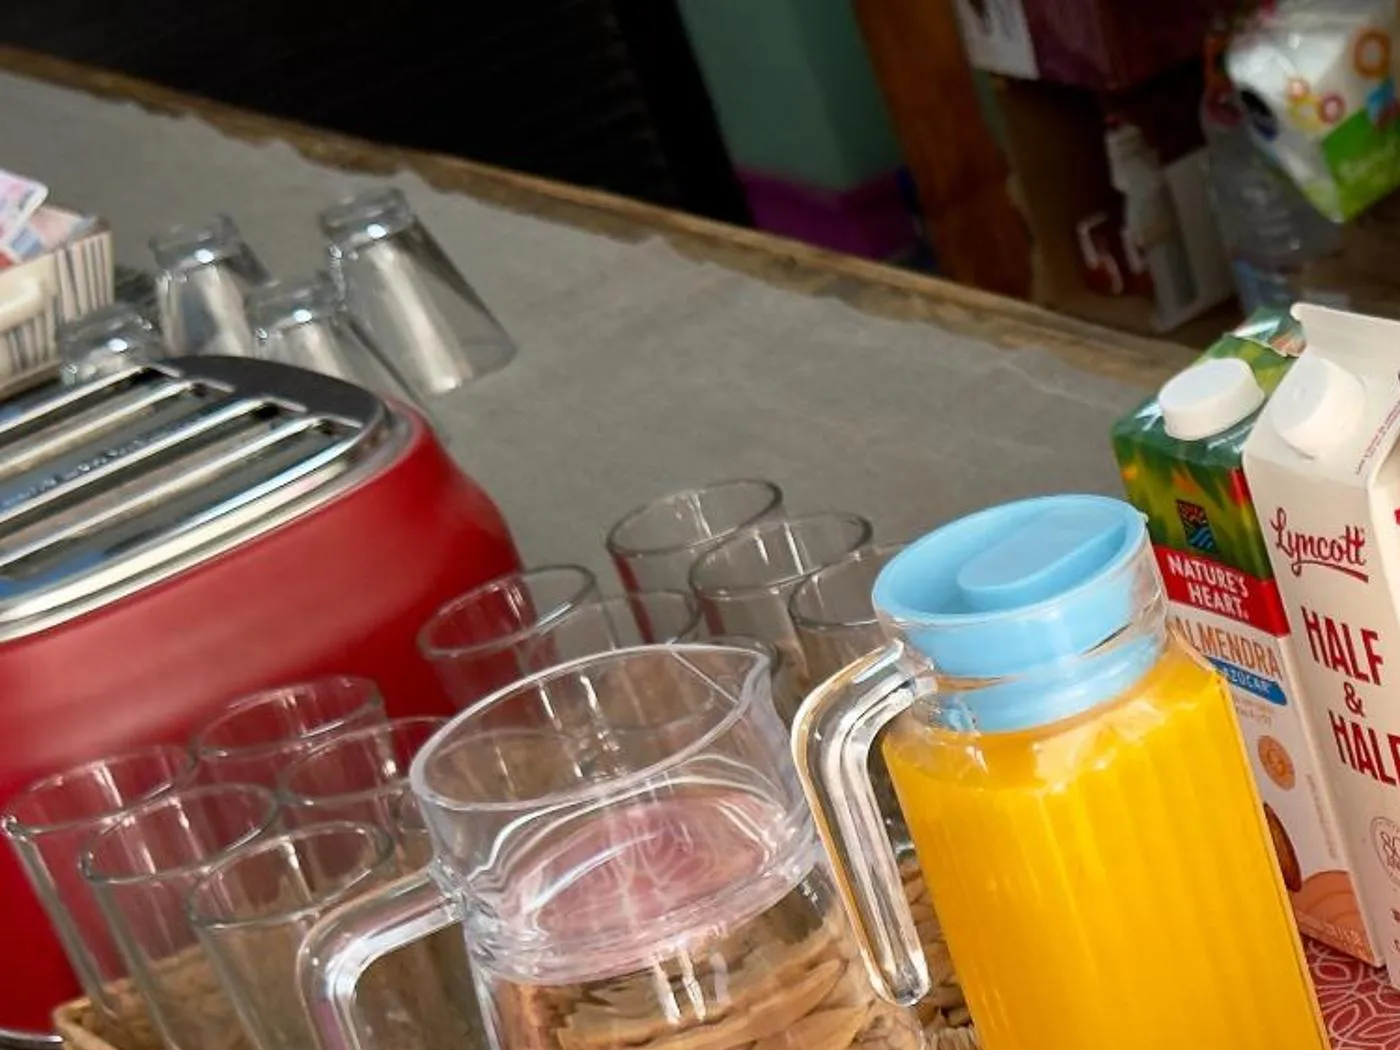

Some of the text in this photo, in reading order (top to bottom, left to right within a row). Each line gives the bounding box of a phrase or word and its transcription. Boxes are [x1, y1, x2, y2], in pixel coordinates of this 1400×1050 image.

[1270, 507, 1368, 583] Lyncott
[1167, 554, 1249, 598] NATURE'S
[1301, 605, 1384, 685] HALF
[1344, 682, 1366, 718] &
